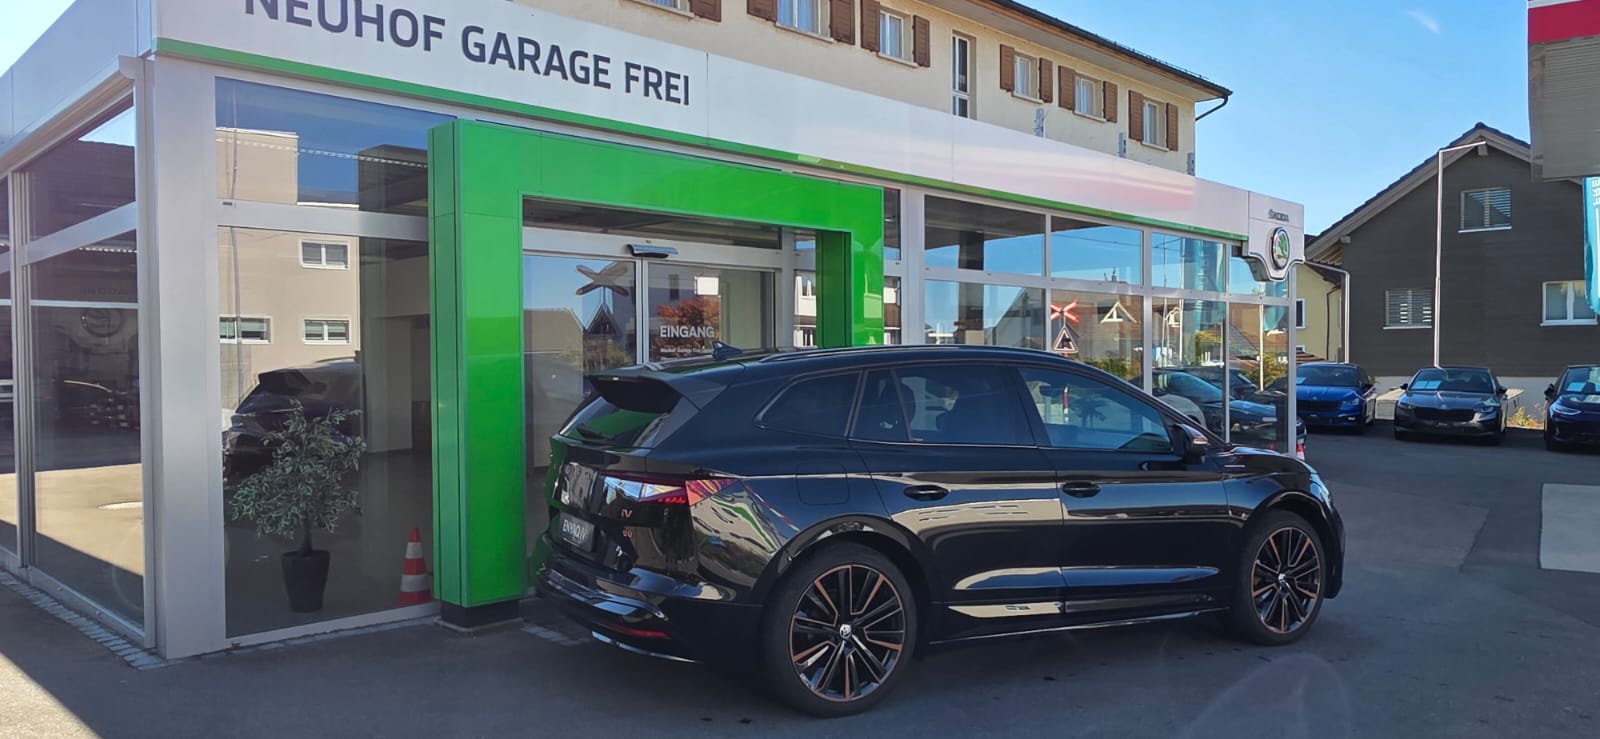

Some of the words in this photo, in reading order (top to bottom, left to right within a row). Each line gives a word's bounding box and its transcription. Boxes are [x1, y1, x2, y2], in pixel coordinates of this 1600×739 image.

[461, 25, 611, 89] GARAGE
[624, 61, 689, 106] FREI
[660, 325, 715, 338] EINGANG
